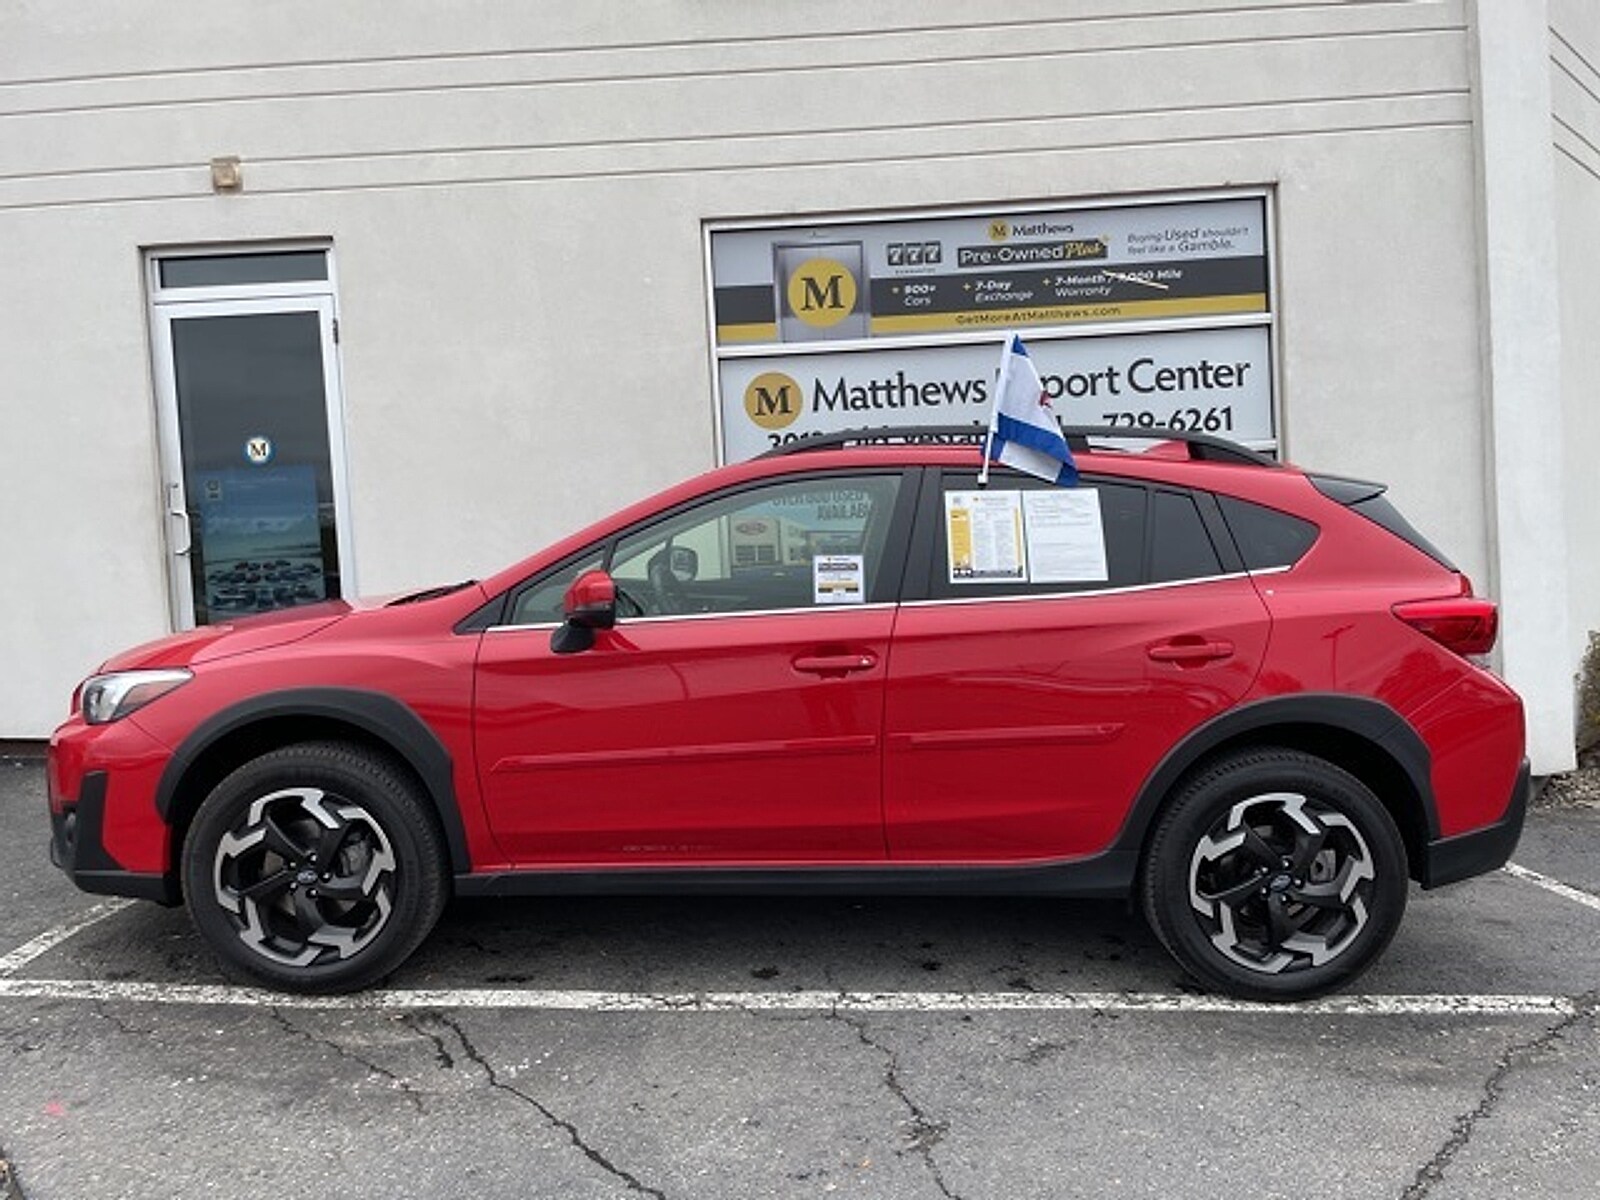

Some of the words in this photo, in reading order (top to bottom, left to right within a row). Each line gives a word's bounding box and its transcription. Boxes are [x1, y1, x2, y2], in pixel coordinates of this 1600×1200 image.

[1012, 222, 1074, 236] Matthews
[1165, 228, 1199, 241] Used
[800, 274, 844, 311] M
[975, 291, 1034, 304] Exchange
[1055, 285, 1112, 297] Warranty
[905, 296, 932, 307] Cars
[955, 306, 1122, 325] GetMoreAtMatthews.com
[754, 385, 792, 416] M
[812, 371, 987, 412] Matthews
[995, 365, 1121, 398] port
[1127, 357, 1251, 394] Center
[250, 442, 266, 457] M
